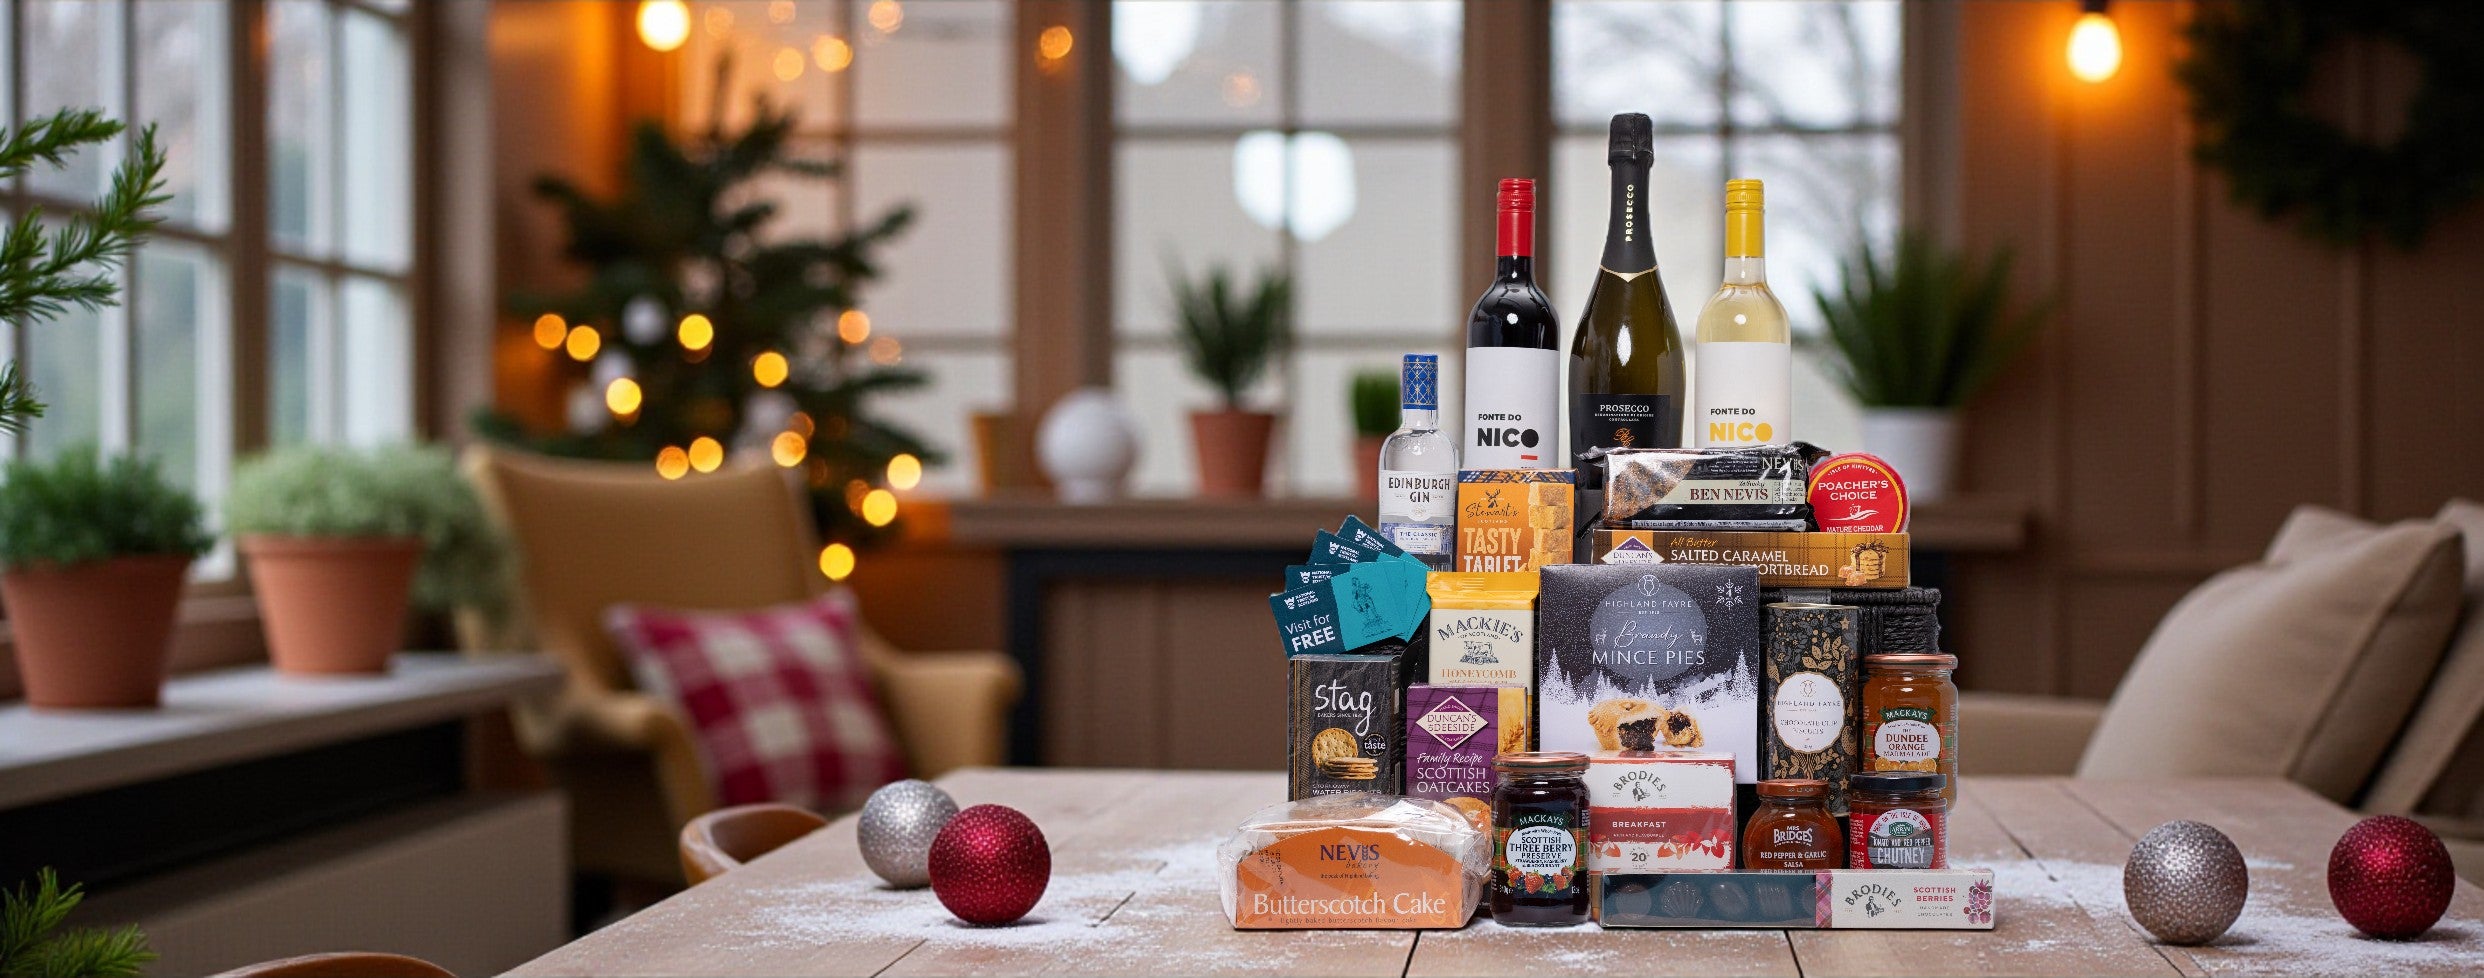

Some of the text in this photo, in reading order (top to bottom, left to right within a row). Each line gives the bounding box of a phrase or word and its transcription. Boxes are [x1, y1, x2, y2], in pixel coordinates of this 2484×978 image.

[1625, 184, 1634, 242] PROSECCO
[1600, 404, 1650, 412] PROSECCO
[1477, 428, 1539, 448] NICO
[1710, 422, 1772, 442] NICO
[1388, 477, 1450, 490] EDINBURGH
[1818, 480, 1889, 490] POACHER'S
[1410, 492, 1430, 502] GIN
[1690, 489, 1720, 500] BEN
[1724, 489, 1768, 500] NEVIS
[1830, 491, 1878, 500] CHOICE
[1465, 502, 1520, 518] Stewart's
[1464, 528, 1522, 554] TASTY
[1670, 537, 1718, 548] All Butter
[1671, 550, 1788, 562] SALTED CARAMEL
[1748, 563, 1828, 576] ORTBREAD
[1285, 614, 1330, 635] Visit for
[1437, 616, 1524, 644] MACKIE'S
[1292, 626, 1336, 652] FREE
[1614, 620, 1682, 649] Brandy
[1592, 650, 1705, 665] MINCE PIES
[1442, 668, 1516, 679] HONEYCOMB
[1428, 714, 1476, 722] DUNCAN'S
[1886, 709, 1928, 720] MACKAYS
[1364, 739, 1386, 750] taste
[1886, 734, 1928, 742] DUNDEE
[1417, 752, 1482, 768] Family Recipe
[1418, 768, 1486, 780] SCOTTISH
[1417, 782, 1490, 793] OATCAKES
[1614, 770, 1666, 792] BRODIES
[1520, 814, 1564, 826] MACKAYS
[1774, 828, 1812, 844] BRIDGES
[1320, 844, 1380, 860] NEVIS
[1510, 844, 1573, 852] THREE BERRY
[1632, 853, 1647, 862] 20
[1878, 848, 1925, 864] CHUTNEY
[1845, 884, 1902, 906] BRODIES
[1254, 892, 1446, 915] Butterscotch Cake
